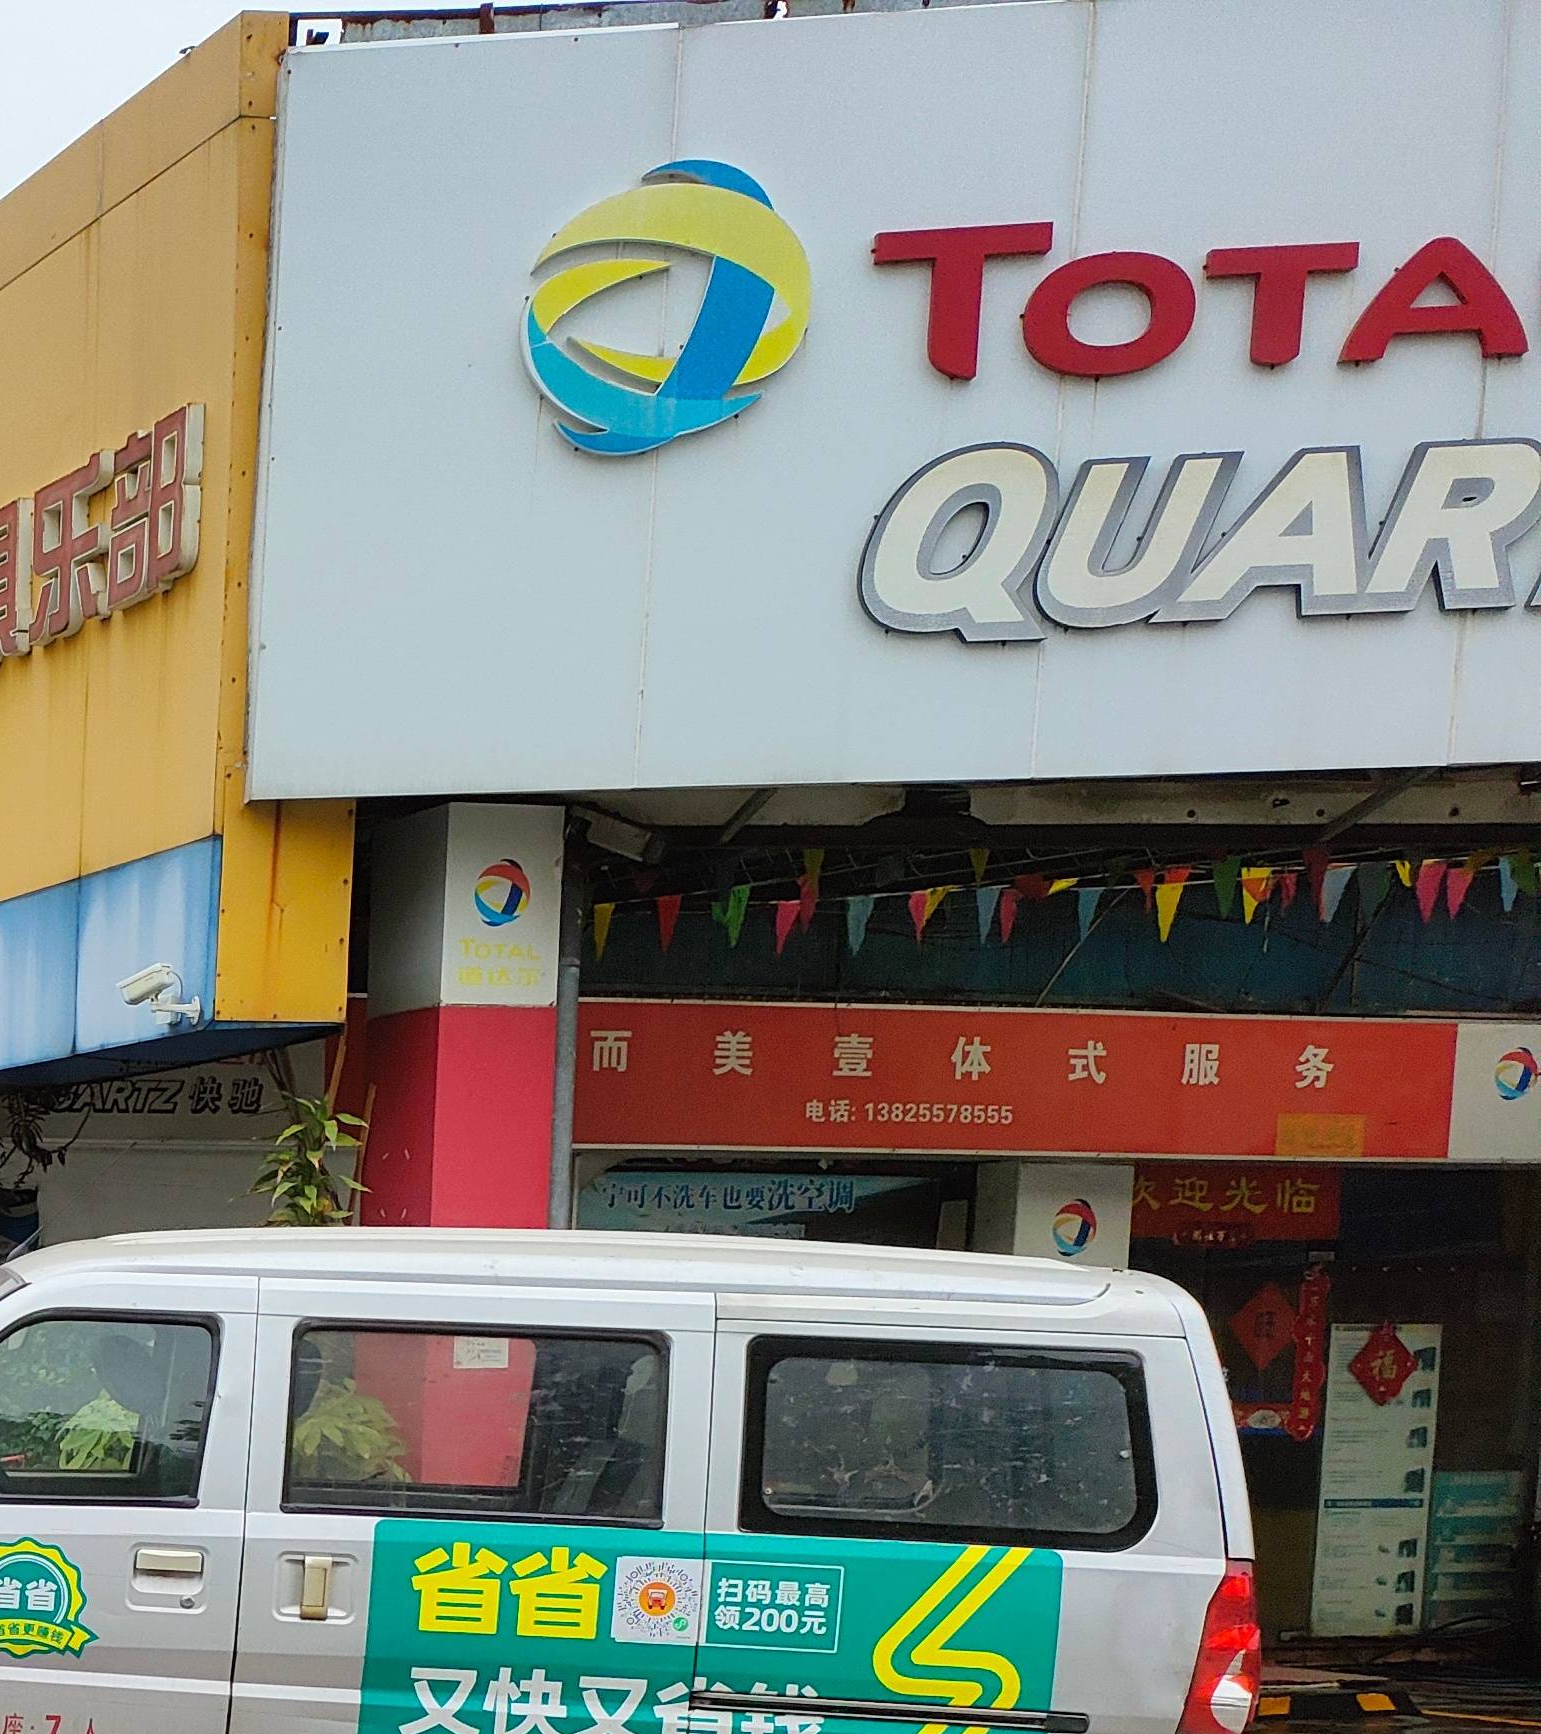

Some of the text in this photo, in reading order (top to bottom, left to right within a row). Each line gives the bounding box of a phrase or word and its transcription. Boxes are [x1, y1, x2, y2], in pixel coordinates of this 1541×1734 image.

[873, 221, 1541, 381] TOTA
[857, 437, 1541, 643] QUAR
[589, 1030, 1335, 1089] 而美壹体式服务
[190, 1076, 263, 1114] 快驰
[865, 1102, 1014, 1126] 13825578555
[1370, 1350, 1398, 1380] 福
[412, 1542, 608, 1640] 省省
[717, 1577, 831, 1608] 扫码最高
[714, 1604, 828, 1636] 领200元
